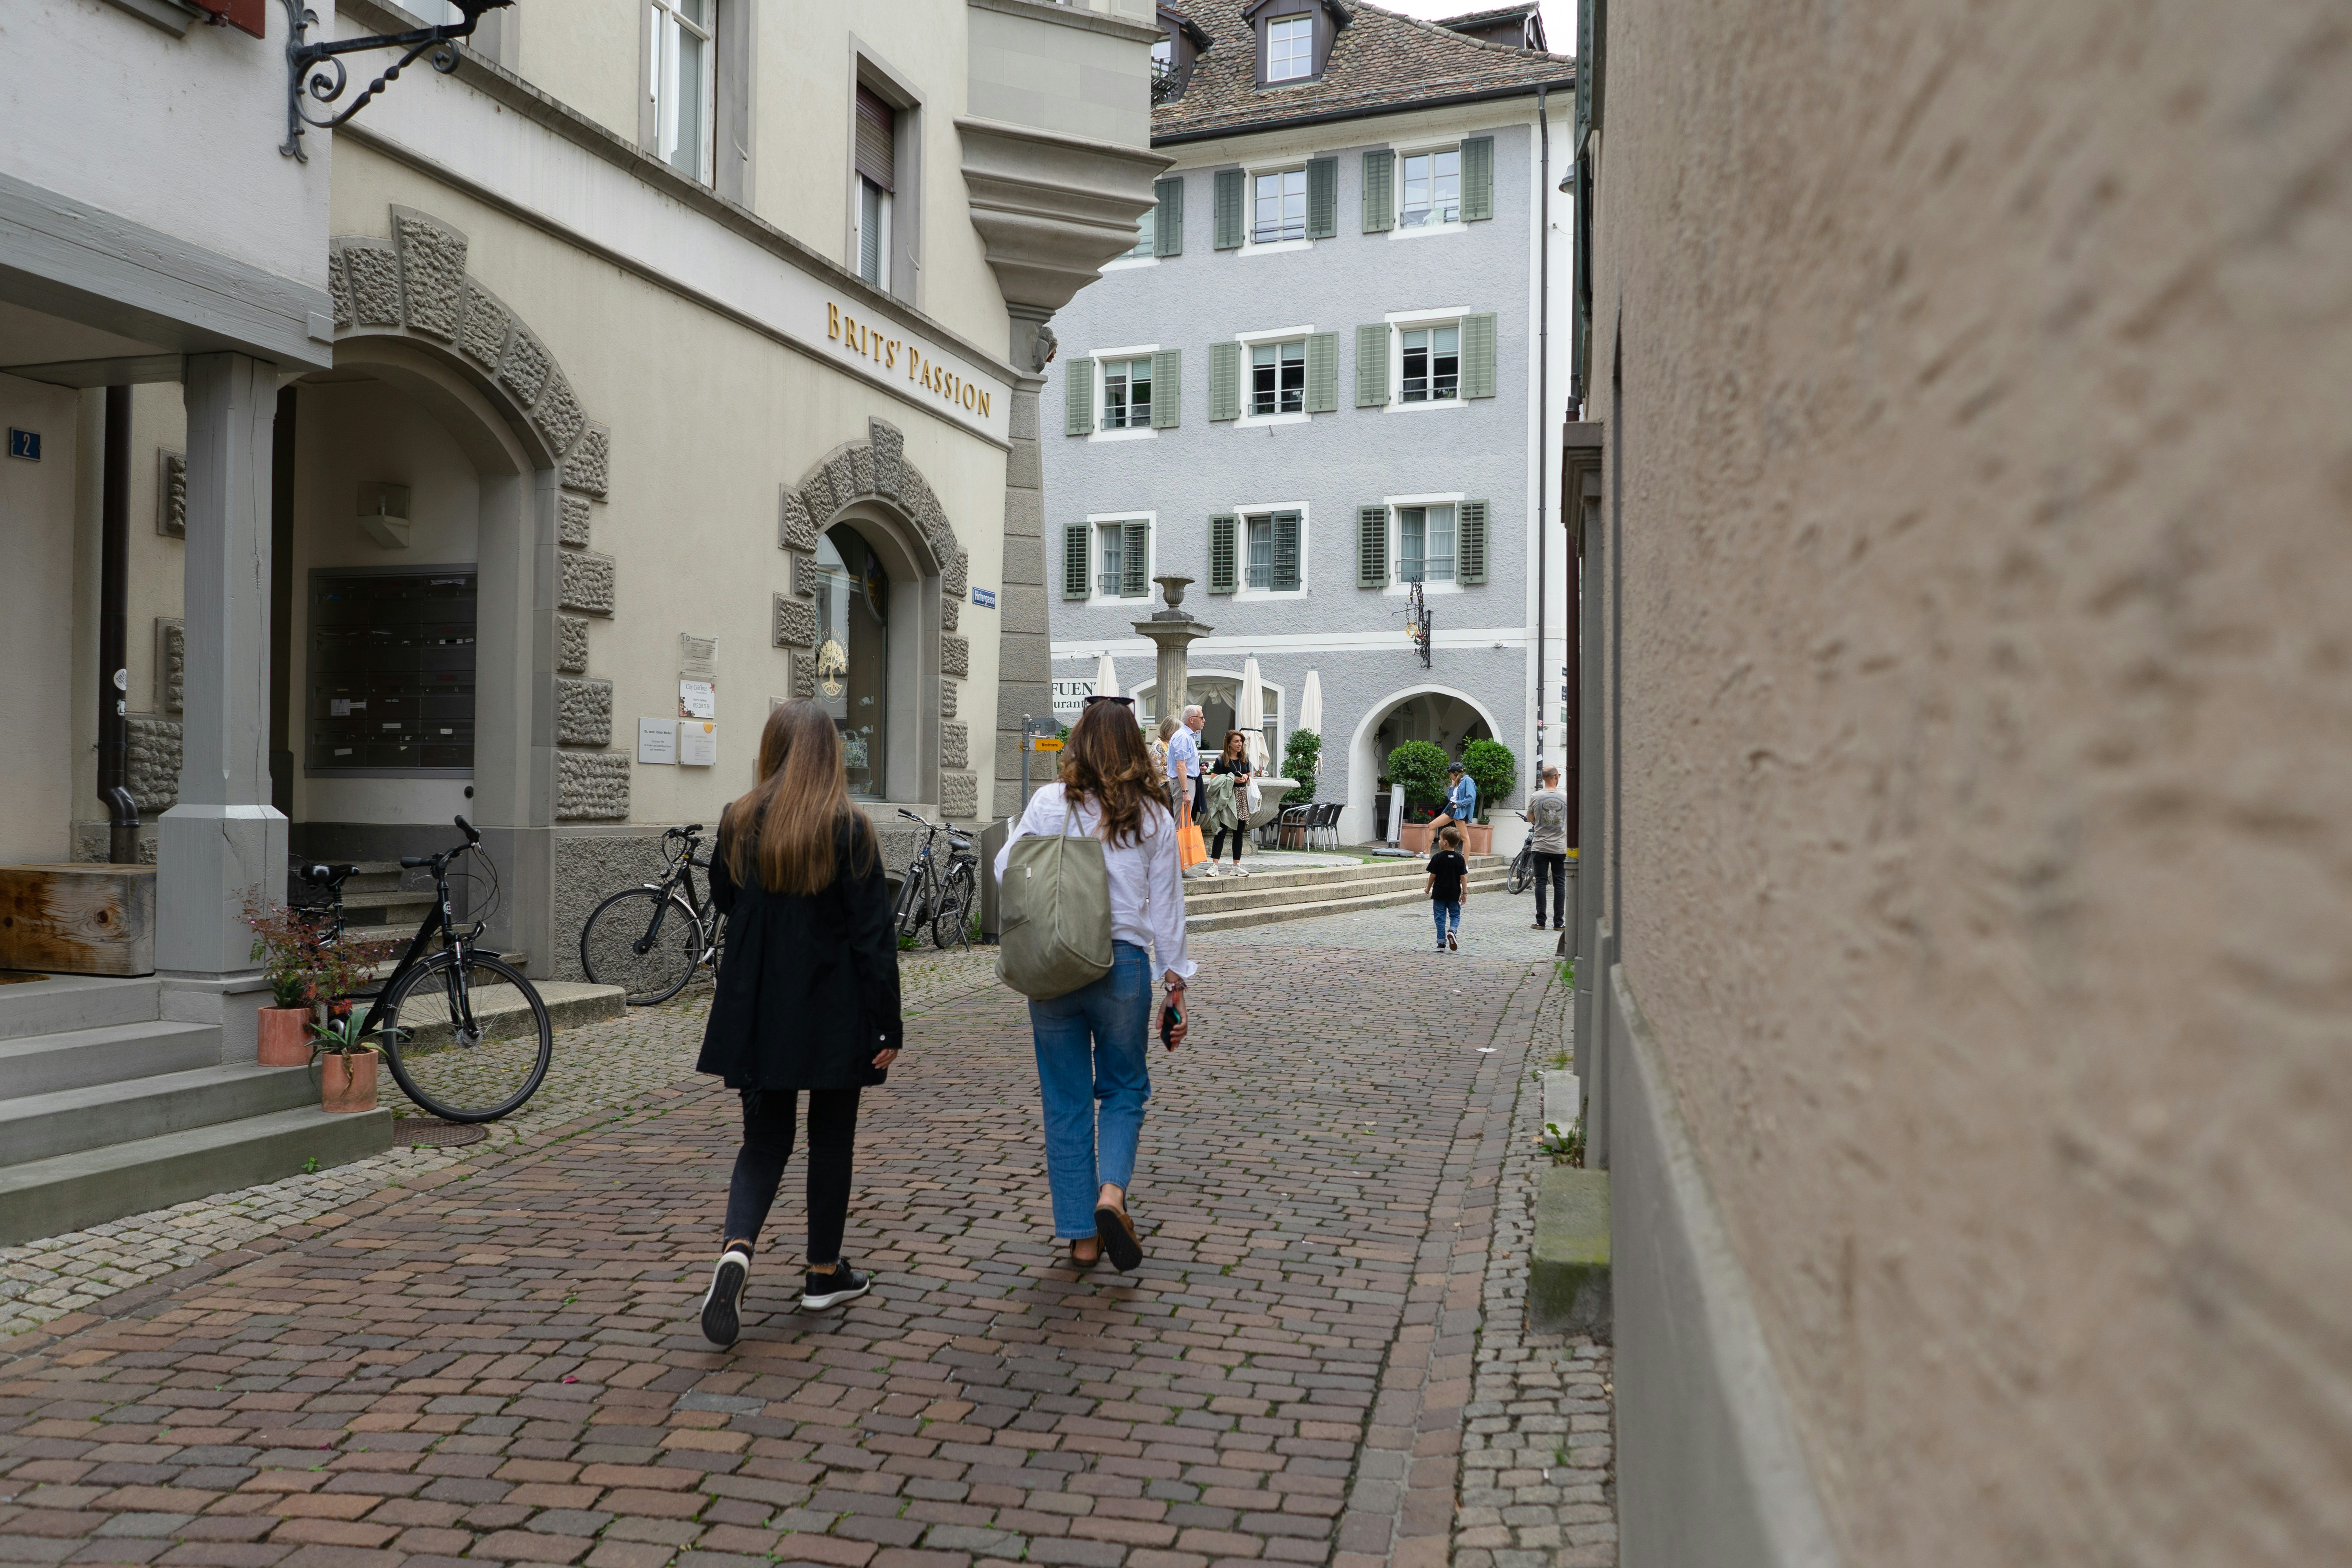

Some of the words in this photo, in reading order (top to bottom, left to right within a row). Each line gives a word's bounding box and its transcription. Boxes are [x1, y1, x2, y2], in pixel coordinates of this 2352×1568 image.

[827, 302, 901, 368] BRITS'
[909, 346, 991, 418] PASSION
[23, 434, 30, 456] 2
[975, 590, 994, 605] Hintergasse
[1052, 682, 1096, 695] FUEN
